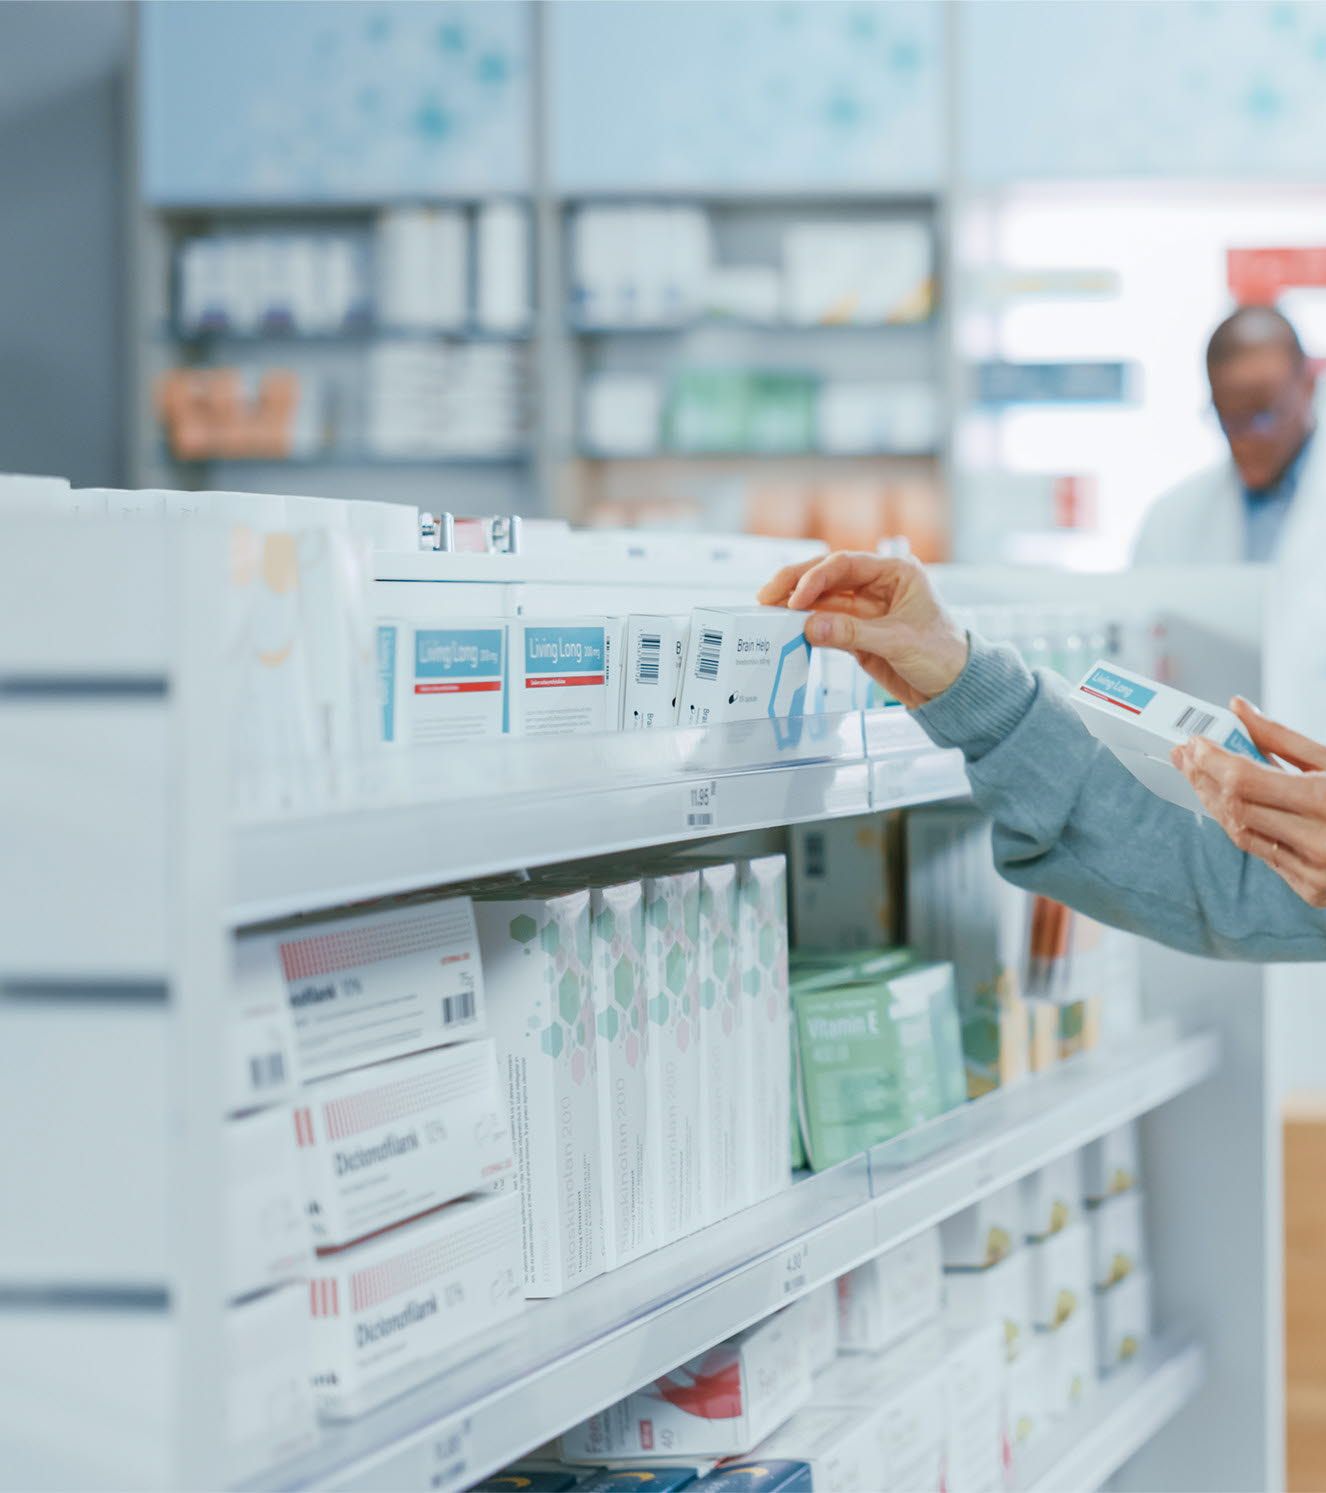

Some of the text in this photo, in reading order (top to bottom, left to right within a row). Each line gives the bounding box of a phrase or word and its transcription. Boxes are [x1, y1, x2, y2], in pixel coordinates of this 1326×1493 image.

[419, 639, 453, 670] Living
[453, 640, 479, 669] Long
[529, 637, 558, 664] Living
[559, 638, 583, 663] Long
[737, 638, 771, 655] Brain Help
[809, 1010, 880, 1040] Vitamin E
[615, 1077, 627, 1120] 200
[560, 1096, 573, 1139] 200
